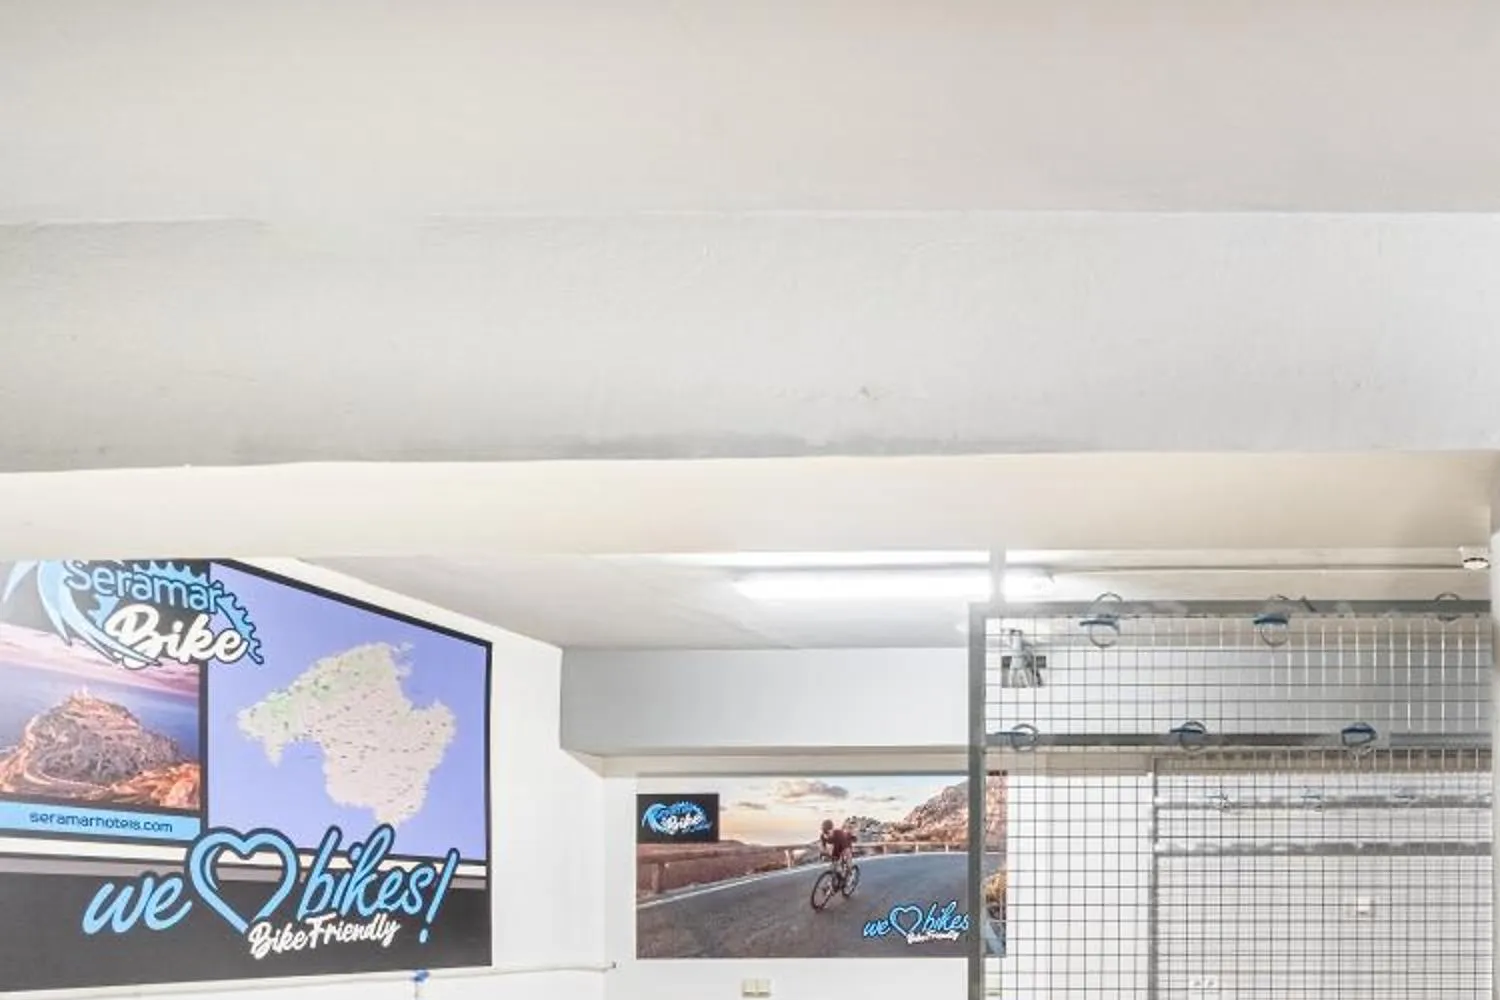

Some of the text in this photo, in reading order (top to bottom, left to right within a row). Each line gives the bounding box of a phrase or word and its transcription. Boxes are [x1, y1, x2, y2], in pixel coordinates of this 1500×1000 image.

[105, 603, 249, 670] Bike
[29, 811, 173, 834] seramarhotels.com
[82, 824, 460, 944] we bikes!
[863, 919, 891, 937] we
